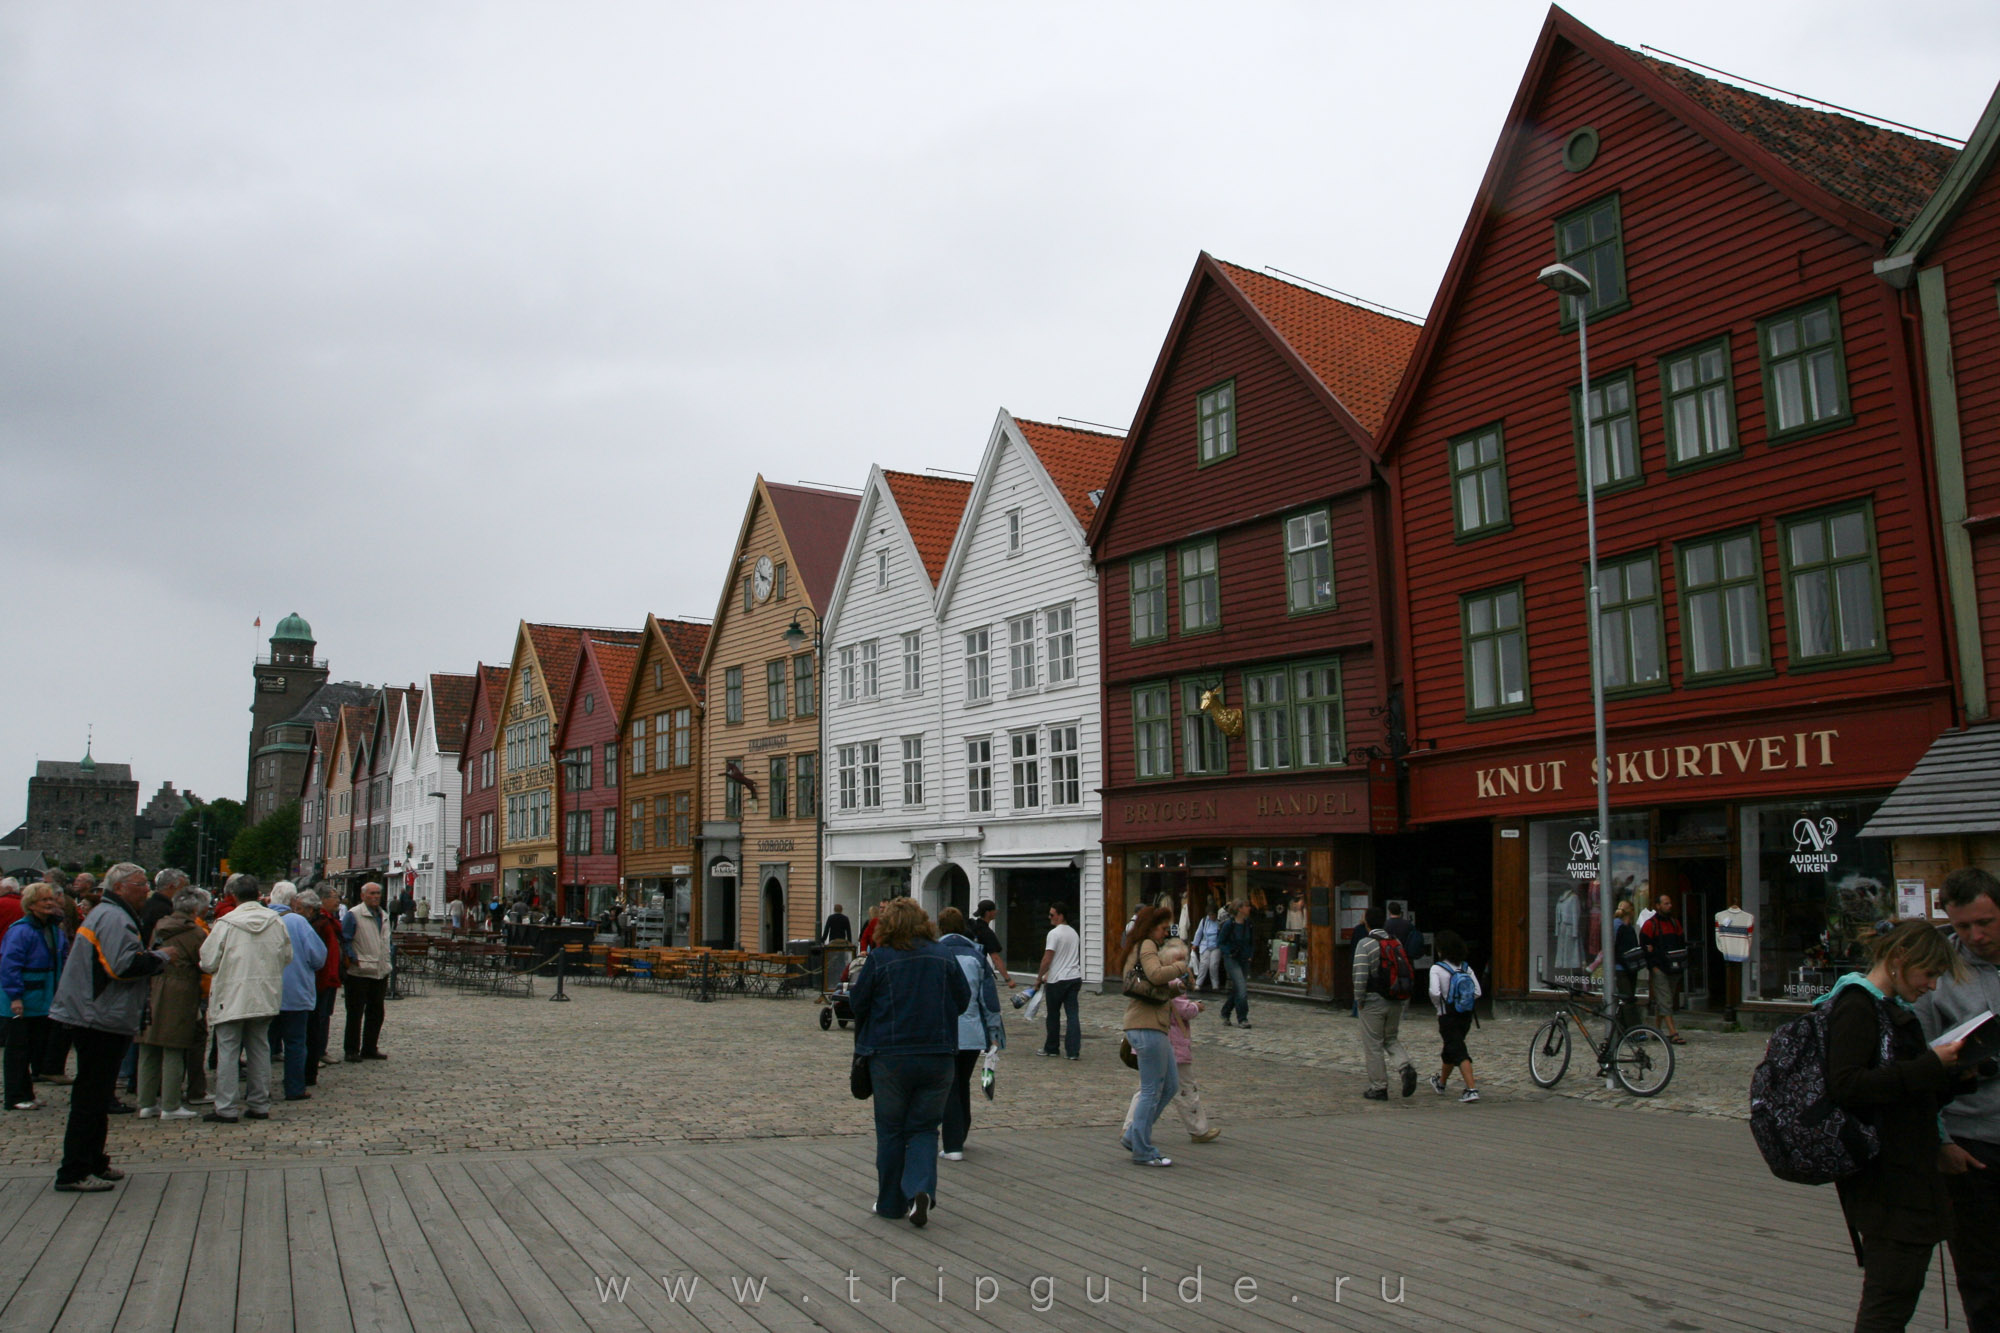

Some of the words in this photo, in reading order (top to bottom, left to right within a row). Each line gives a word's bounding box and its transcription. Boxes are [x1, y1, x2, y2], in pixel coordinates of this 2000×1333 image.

[1476, 760, 1567, 799] KNUT
[1590, 729, 1840, 787] SKURTVEIT
[1256, 792, 1357, 817] HANDEL
[1789, 853, 1838, 864] AUDHILD
[1566, 862, 1600, 871] AUDHIL
[1795, 863, 1829, 873] VIKEN
[1570, 870, 1596, 879] VIKEN
[1554, 975, 1590, 985] MEMORIES
[1783, 984, 1831, 995] MEMORIES
